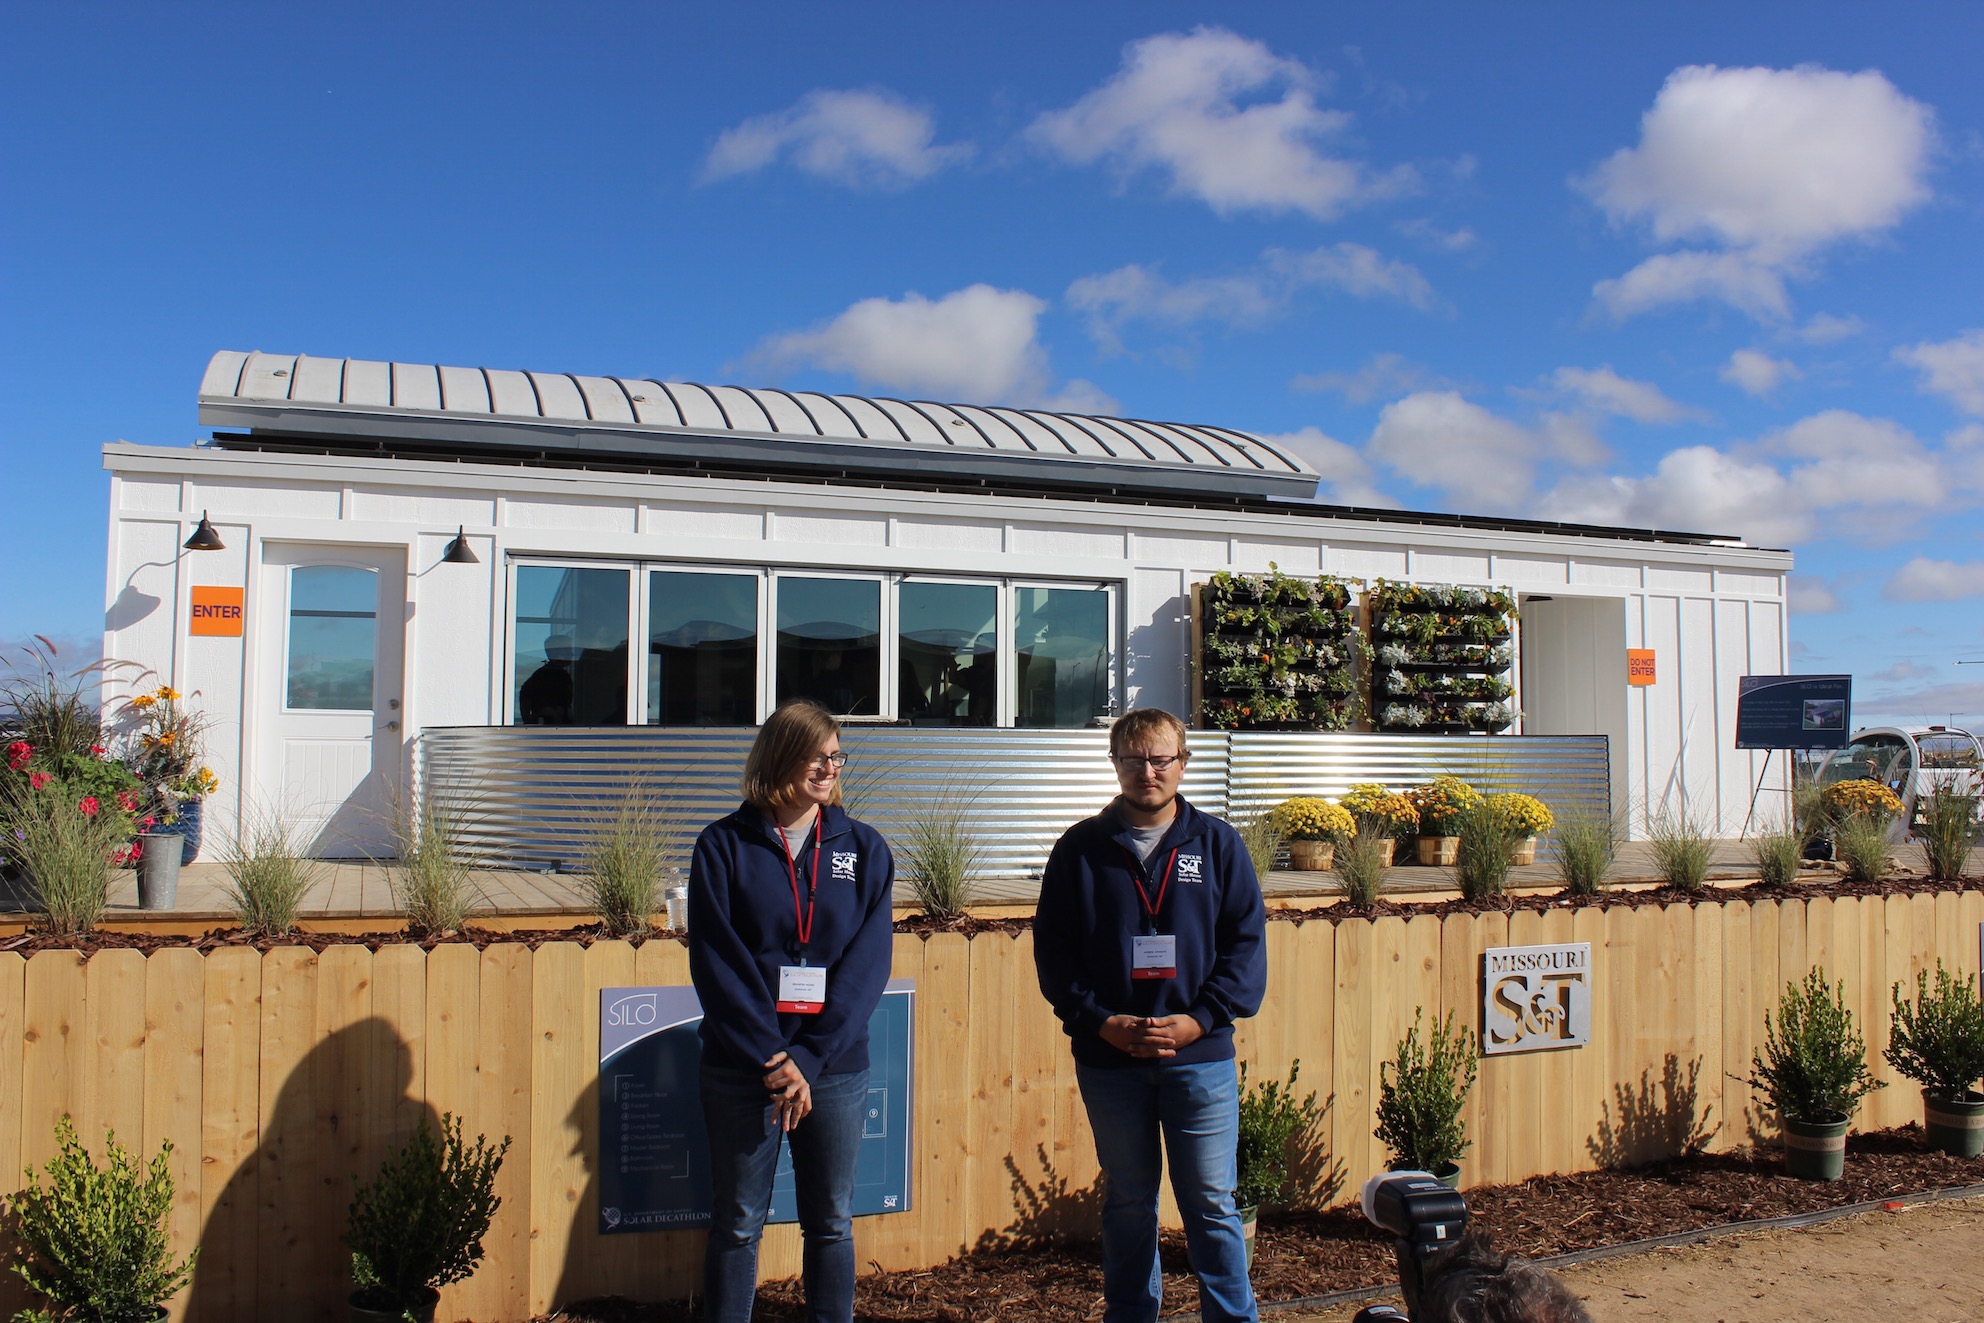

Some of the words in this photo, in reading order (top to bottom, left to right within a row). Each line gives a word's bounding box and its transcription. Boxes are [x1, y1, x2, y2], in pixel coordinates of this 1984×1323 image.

[193, 604, 241, 619] ENTER
[1630, 658, 1640, 666] DO
[1641, 658, 1655, 667] NOT
[1631, 667, 1655, 676] ENTER
[832, 857, 857, 872] S&T
[1178, 859, 1202, 874] S&T
[1492, 951, 1586, 972] MISSOURI
[608, 993, 657, 1026] SILO
[1491, 973, 1586, 1046] S&T
[623, 1215, 653, 1225] SOLAR
[655, 1211, 712, 1223] DECATHLON
